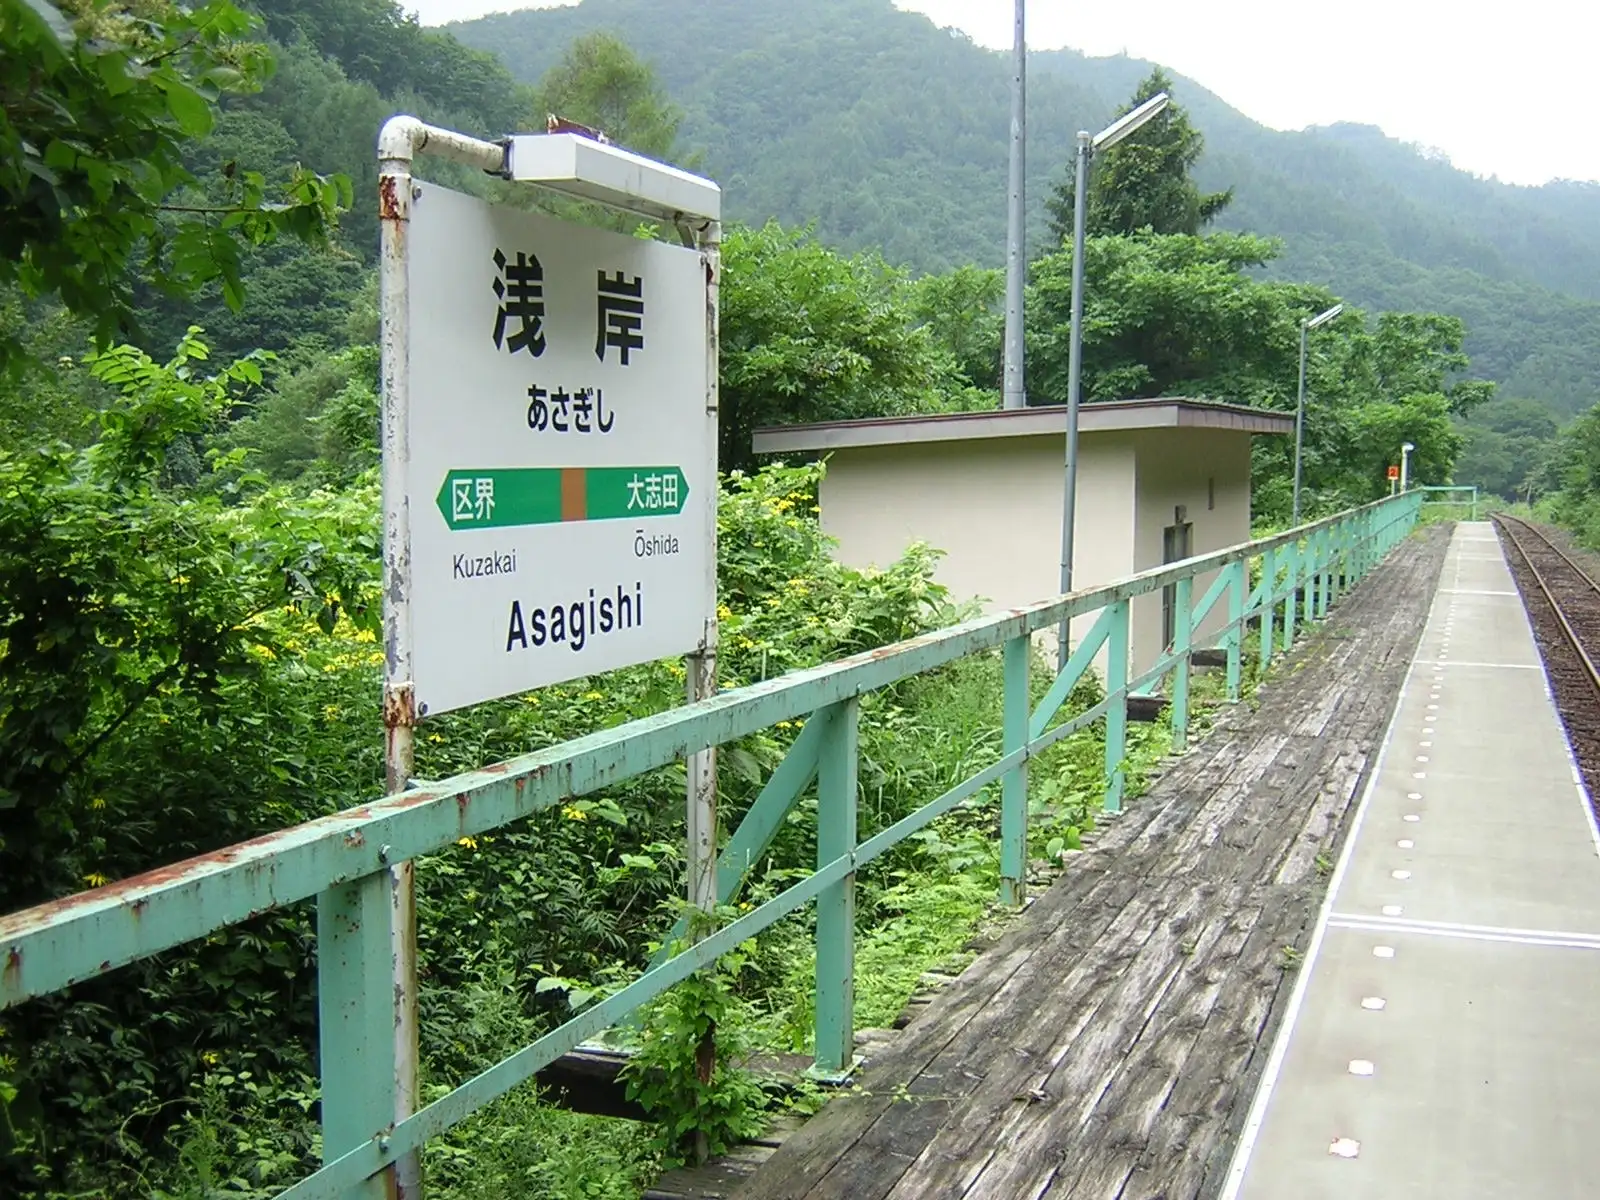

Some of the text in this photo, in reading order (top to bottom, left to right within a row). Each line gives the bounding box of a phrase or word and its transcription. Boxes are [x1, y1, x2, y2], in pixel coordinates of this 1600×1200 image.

[492, 247, 645, 366] 浅岸
[527, 383, 615, 433] あさぎし
[452, 478, 496, 522] 区界
[626, 473, 678, 510] 大志田
[453, 548, 517, 580] Kuzakai
[634, 529, 679, 558] Ōshida
[506, 581, 642, 653] Asagishi
